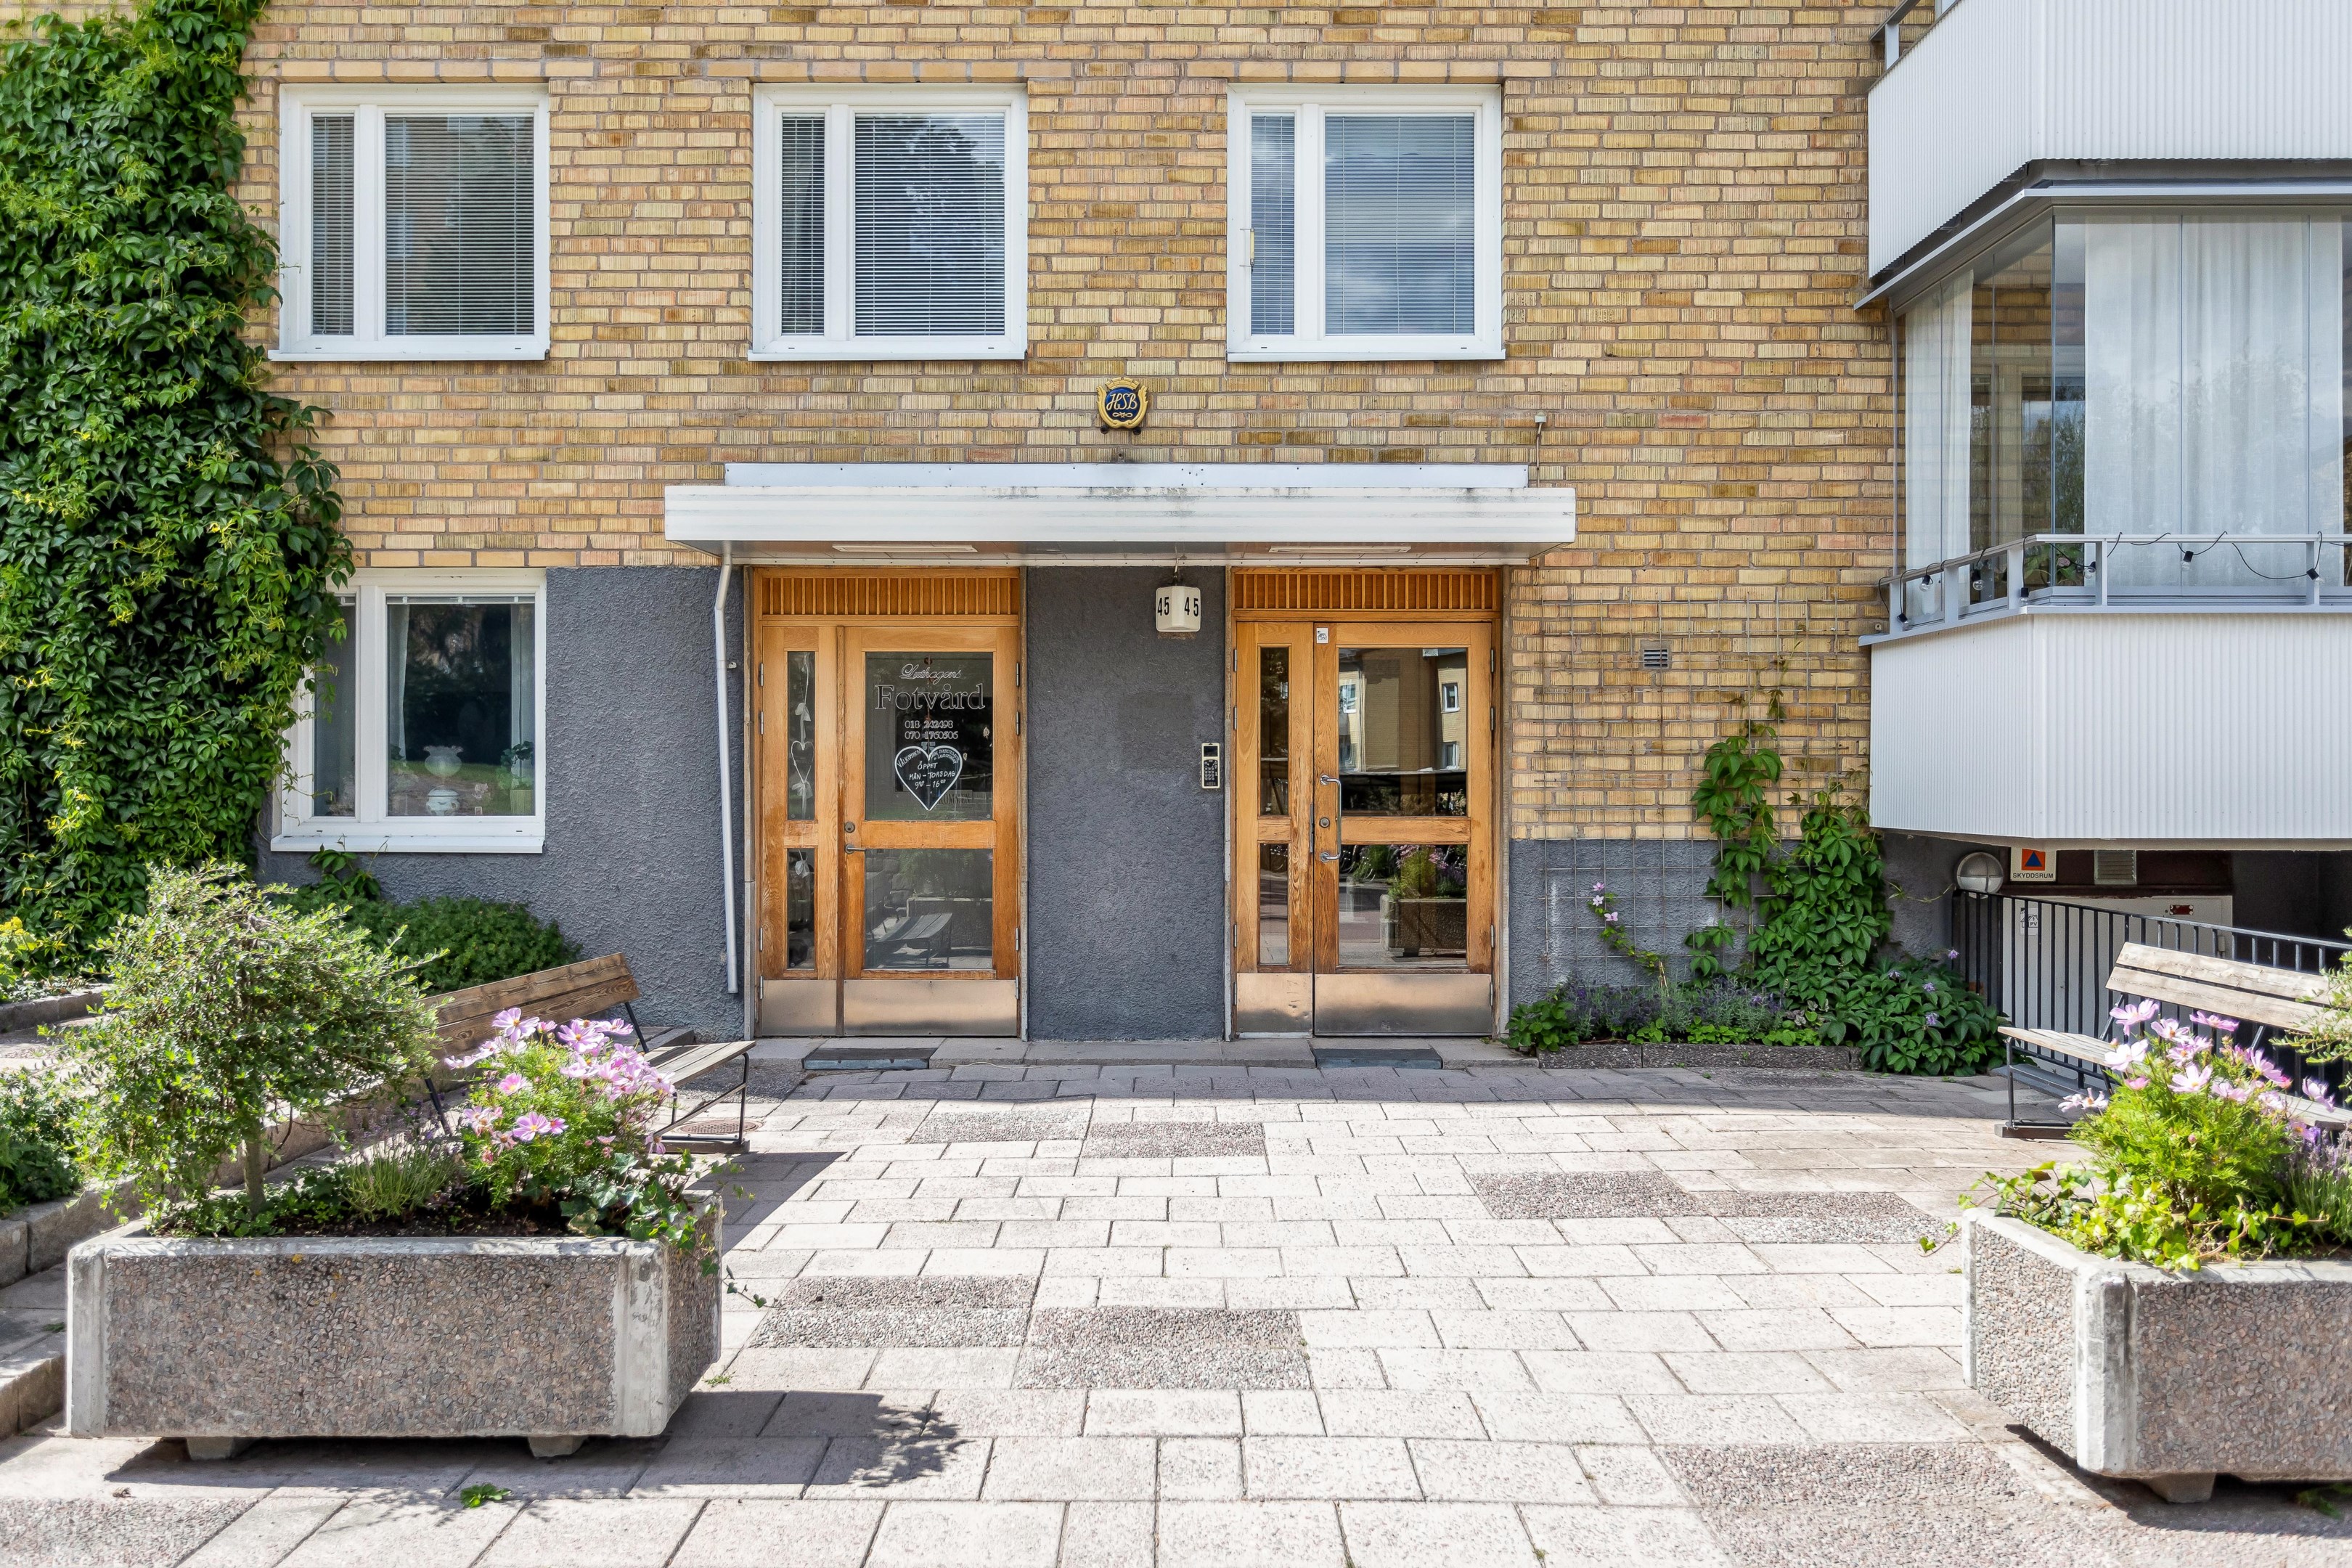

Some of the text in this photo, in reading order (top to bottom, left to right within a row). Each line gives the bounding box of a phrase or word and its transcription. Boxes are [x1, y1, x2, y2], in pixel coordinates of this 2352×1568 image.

[1106, 393, 1138, 411] HSB
[1157, 596, 1169, 616] 45
[1184, 597, 1199, 617] 45
[899, 663, 961, 685] Luthagens
[875, 683, 985, 710] Fotvård
[905, 720, 920, 729] 018
[905, 731, 920, 740] 070
[917, 761, 938, 770] ÖPPET
